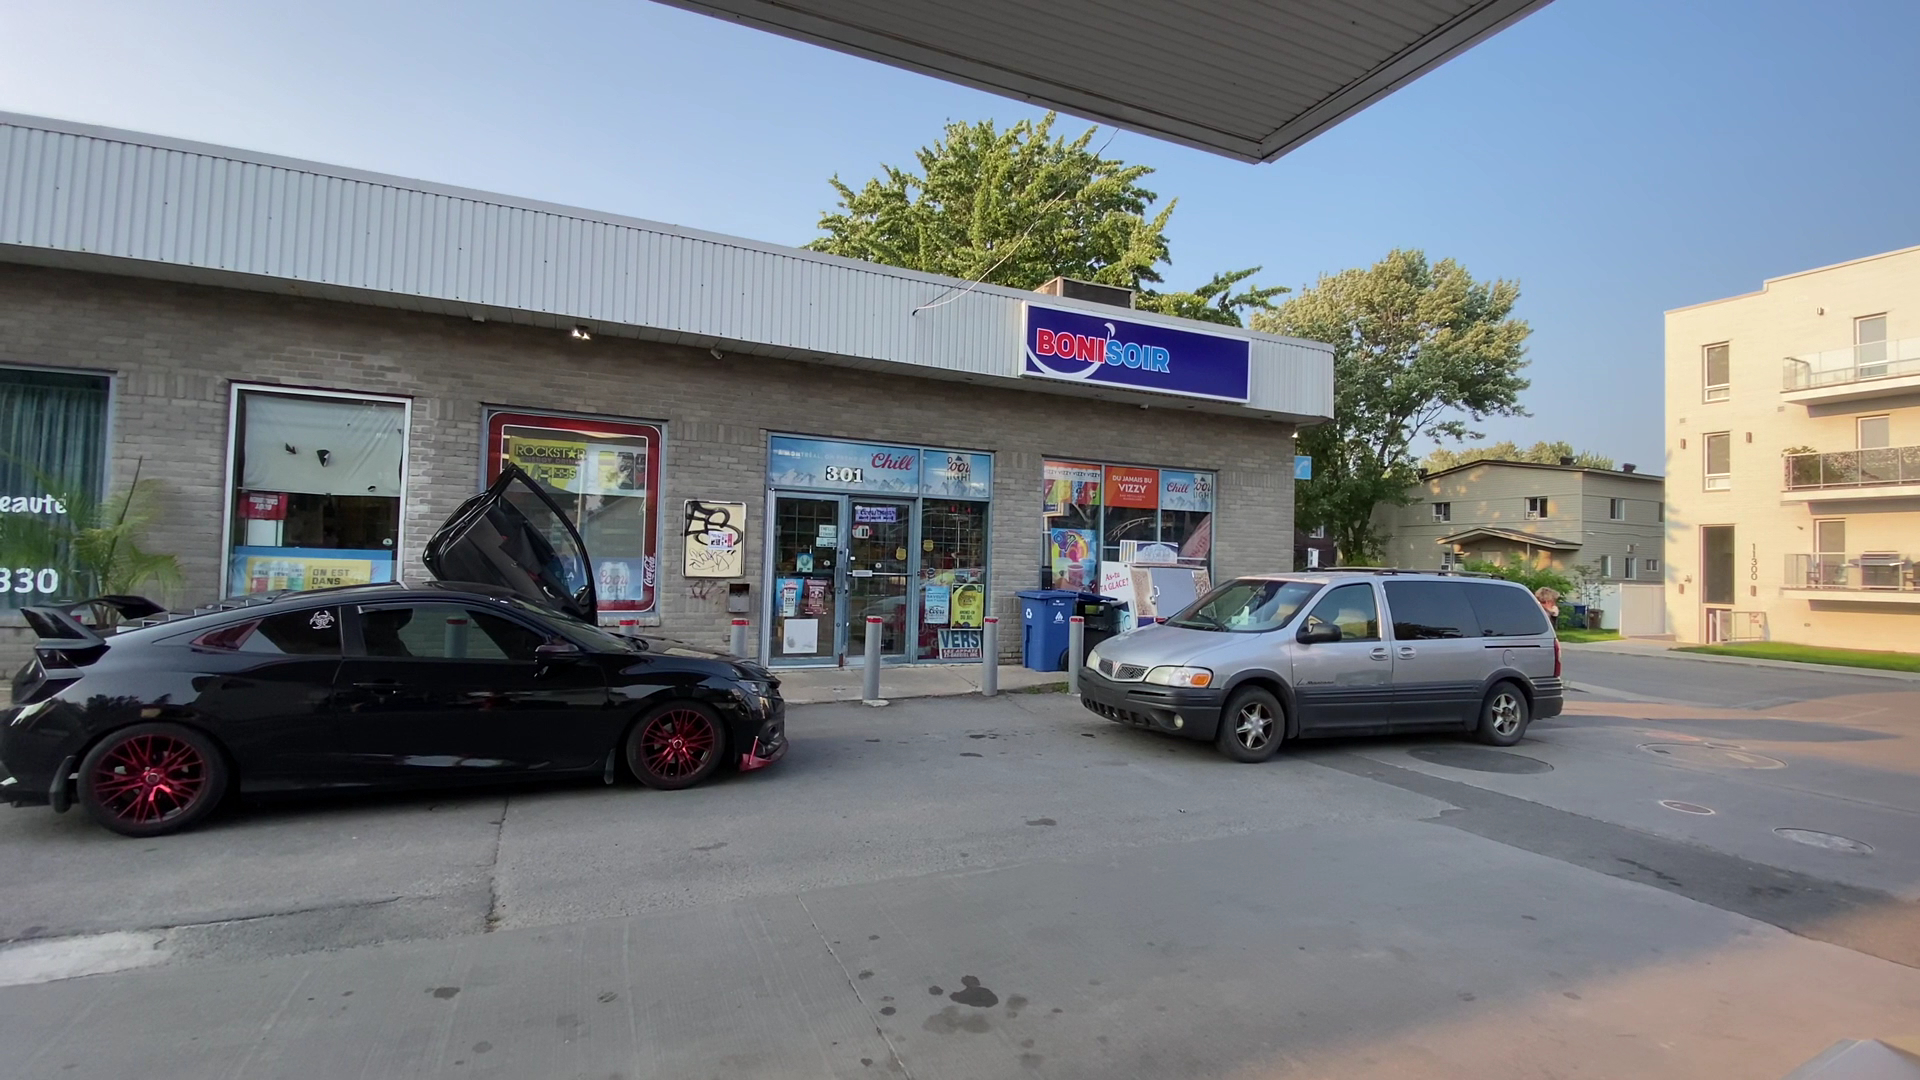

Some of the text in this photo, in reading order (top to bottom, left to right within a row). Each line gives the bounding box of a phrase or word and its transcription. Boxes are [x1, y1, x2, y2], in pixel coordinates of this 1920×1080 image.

[871, 452, 916, 471] Chill
[826, 466, 863, 483] 301
[1118, 483, 1147, 494] VIZZY
[1166, 481, 1189, 494] Chill
[312, 568, 327, 577] ON
[331, 568, 350, 577] EST
[311, 577, 341, 586] DANS
[1108, 577, 1129, 591] GLACE?
[940, 630, 980, 648] VERS
